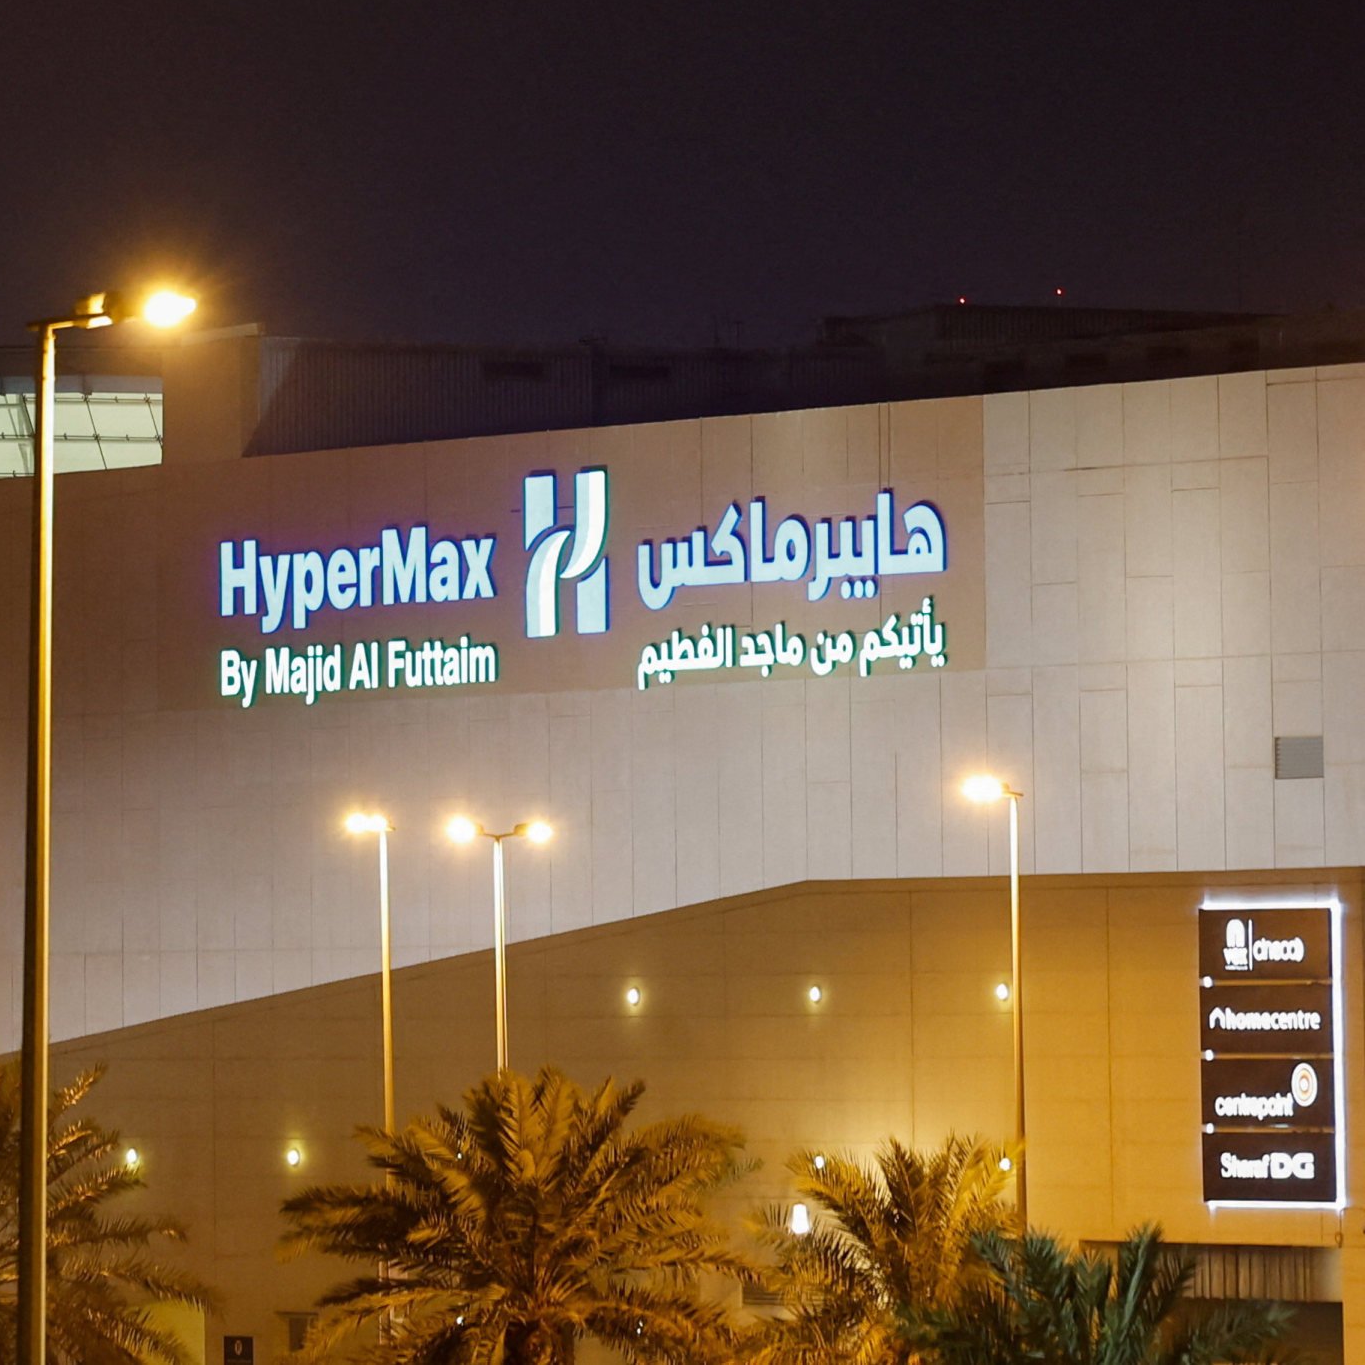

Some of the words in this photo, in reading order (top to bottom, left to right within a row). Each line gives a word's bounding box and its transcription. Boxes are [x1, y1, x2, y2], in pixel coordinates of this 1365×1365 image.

[220, 526, 496, 634] HyperMax
[636, 491, 946, 611] هايبرماكس
[221, 649, 257, 708] By
[265, 643, 341, 705] Majid
[349, 641, 379, 690] Al
[388, 635, 496, 688] Futtaim
[637, 624, 734, 690] الفطيم
[739, 623, 804, 677] ماجد
[810, 629, 856, 676] من
